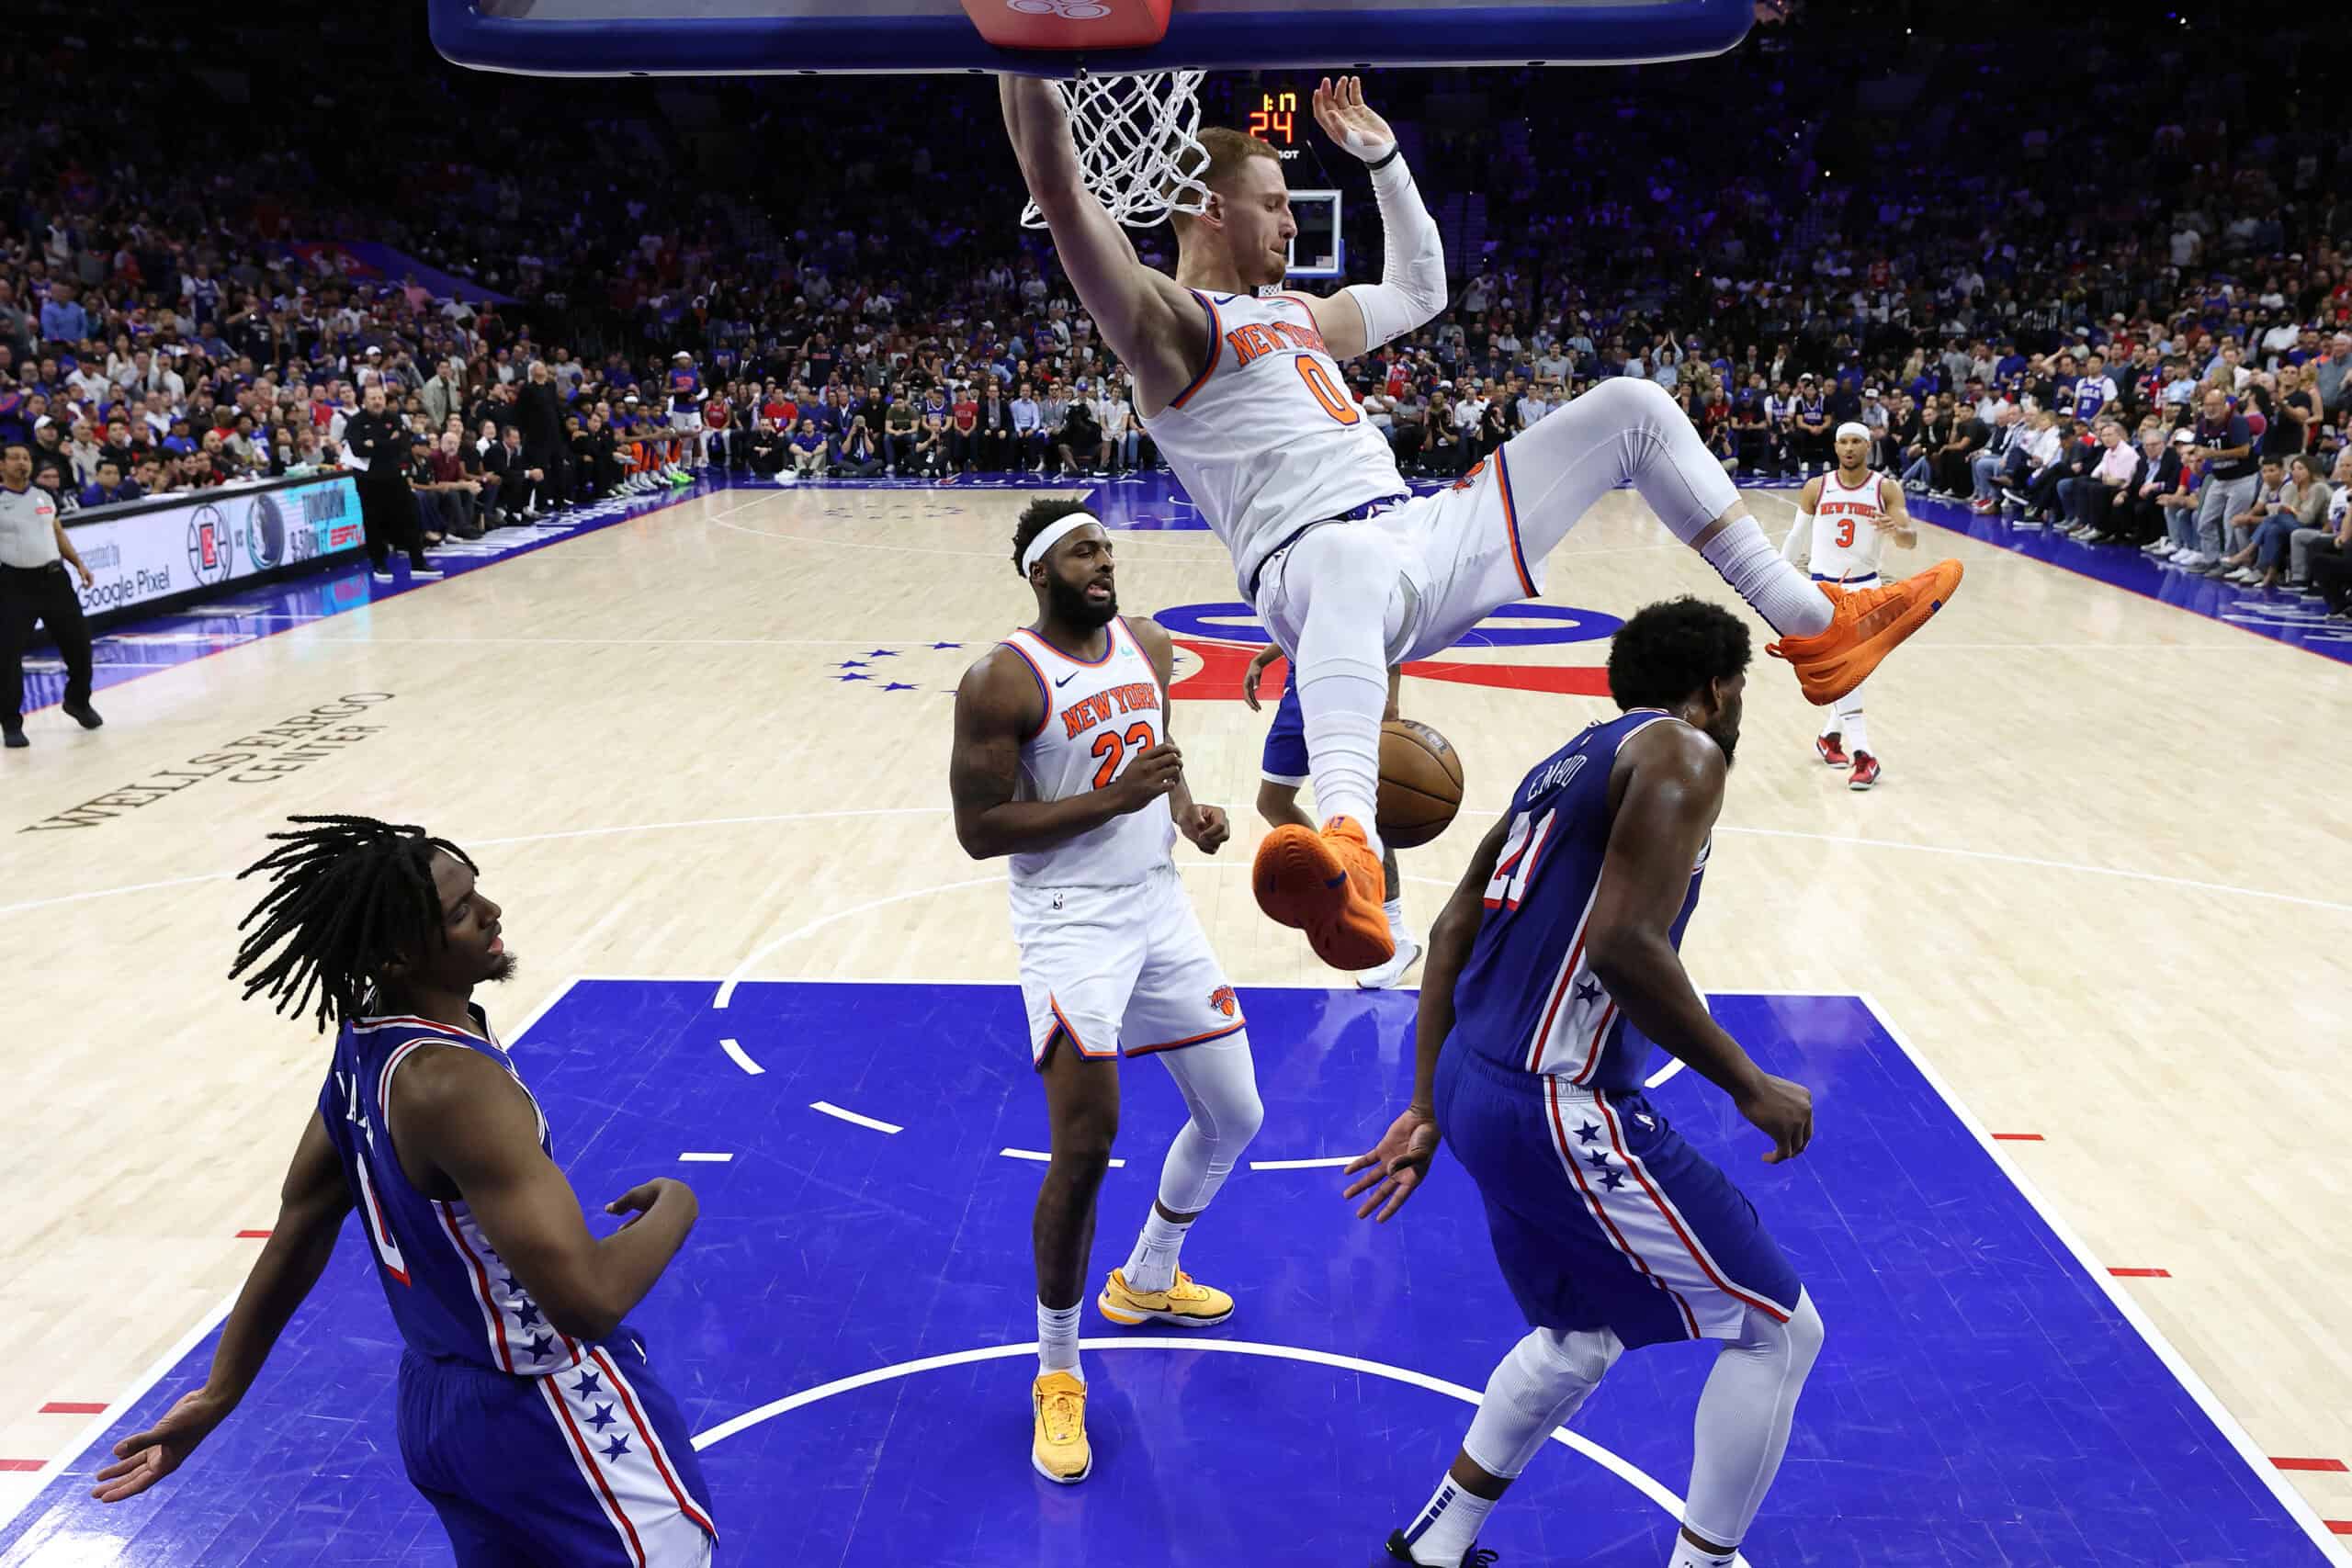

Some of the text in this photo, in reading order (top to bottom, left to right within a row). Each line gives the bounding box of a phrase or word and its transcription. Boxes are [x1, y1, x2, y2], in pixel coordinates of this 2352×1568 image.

[1263, 93, 1296, 112] 1:17
[1250, 112, 1292, 143] 24
[1227, 322, 1288, 367] NEW
[1295, 354, 1361, 426] 0
[1820, 501, 1845, 515] NEW
[1836, 518, 1856, 547] 3
[77, 563, 171, 610] Google Pixel
[1060, 682, 1160, 740] NEW YORK
[16, 692, 395, 833] WELLS FARGO
[228, 722, 389, 783] CENTER
[1483, 807, 1556, 911] 21
